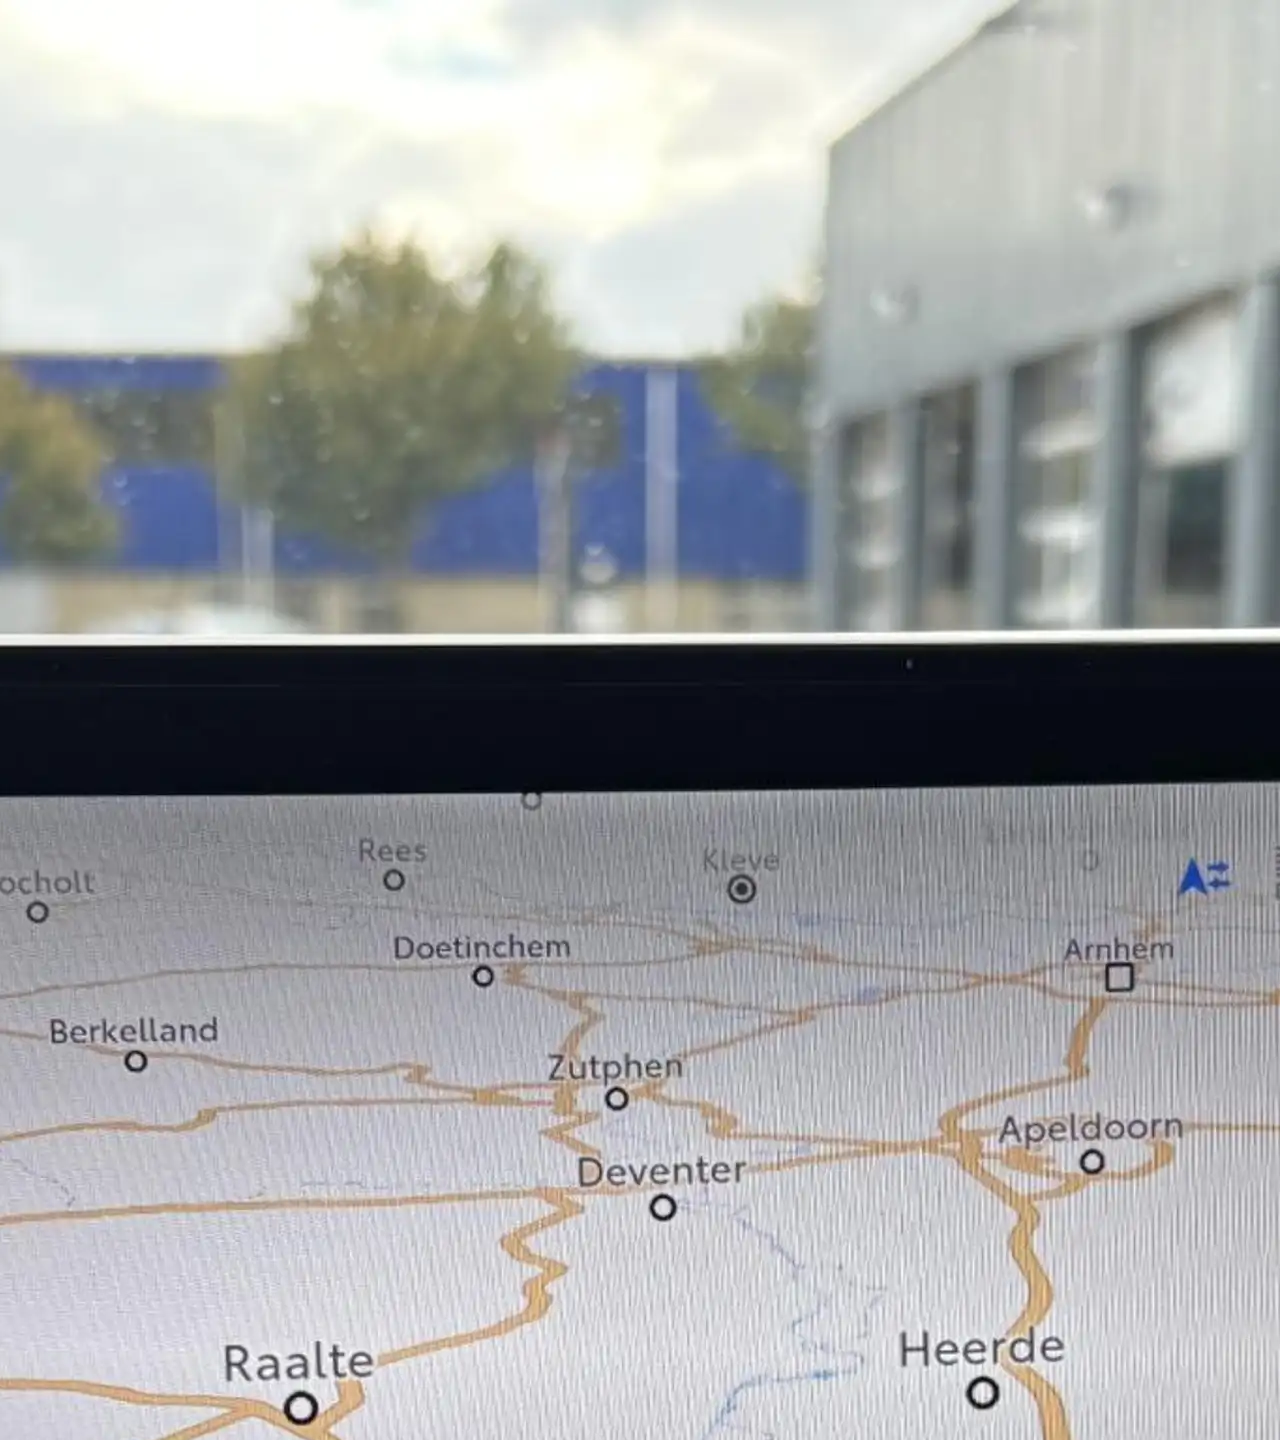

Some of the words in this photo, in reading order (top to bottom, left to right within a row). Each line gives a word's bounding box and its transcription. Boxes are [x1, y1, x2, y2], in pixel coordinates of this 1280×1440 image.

[359, 838, 427, 863] Rees
[703, 847, 780, 874] Kleve
[394, 933, 571, 962] Doetinchem
[1065, 937, 1175, 962] Arnhem
[49, 1015, 218, 1046] Berkelland
[548, 1053, 683, 1088] Zutphen
[999, 1114, 1183, 1146] Apeldoorn
[577, 1156, 747, 1188] Deventer
[224, 1342, 376, 1382] Raalte
[899, 1330, 1066, 1368] Heerde
